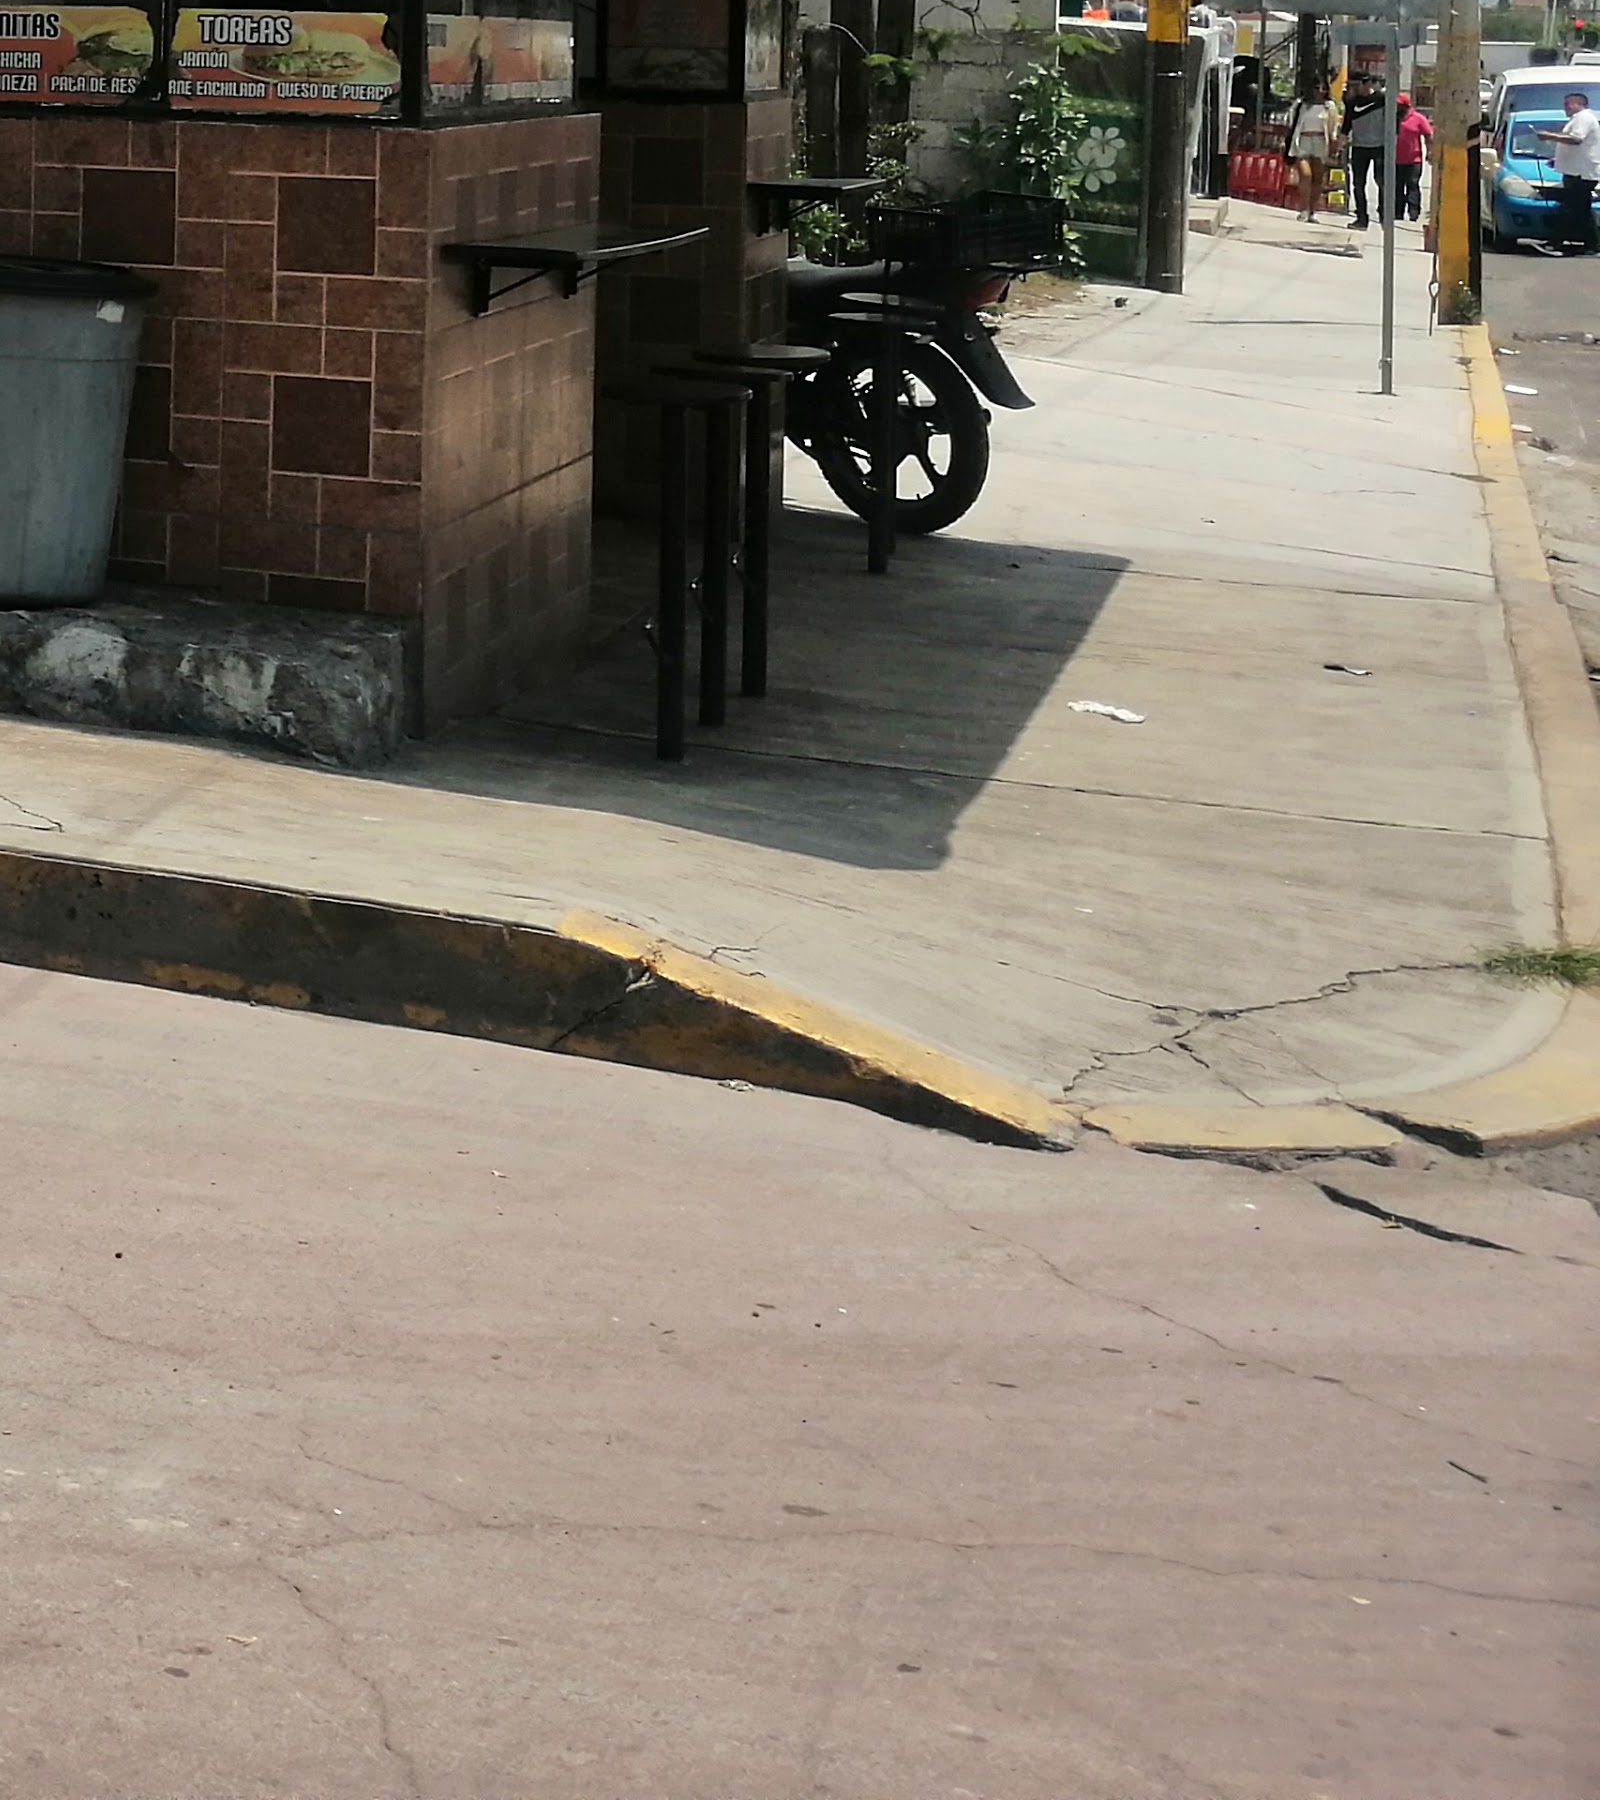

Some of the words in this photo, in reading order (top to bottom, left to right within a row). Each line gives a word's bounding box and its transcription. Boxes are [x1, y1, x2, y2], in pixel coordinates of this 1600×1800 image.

[198, 16, 292, 45] TORTAS
[178, 47, 228, 68] JAMÓN
[90, 76, 106, 92] DE
[111, 77, 136, 93] RES
[196, 80, 265, 98] ENCHILADA
[277, 82, 318, 98] QUESO
[322, 84, 338, 99] DE
